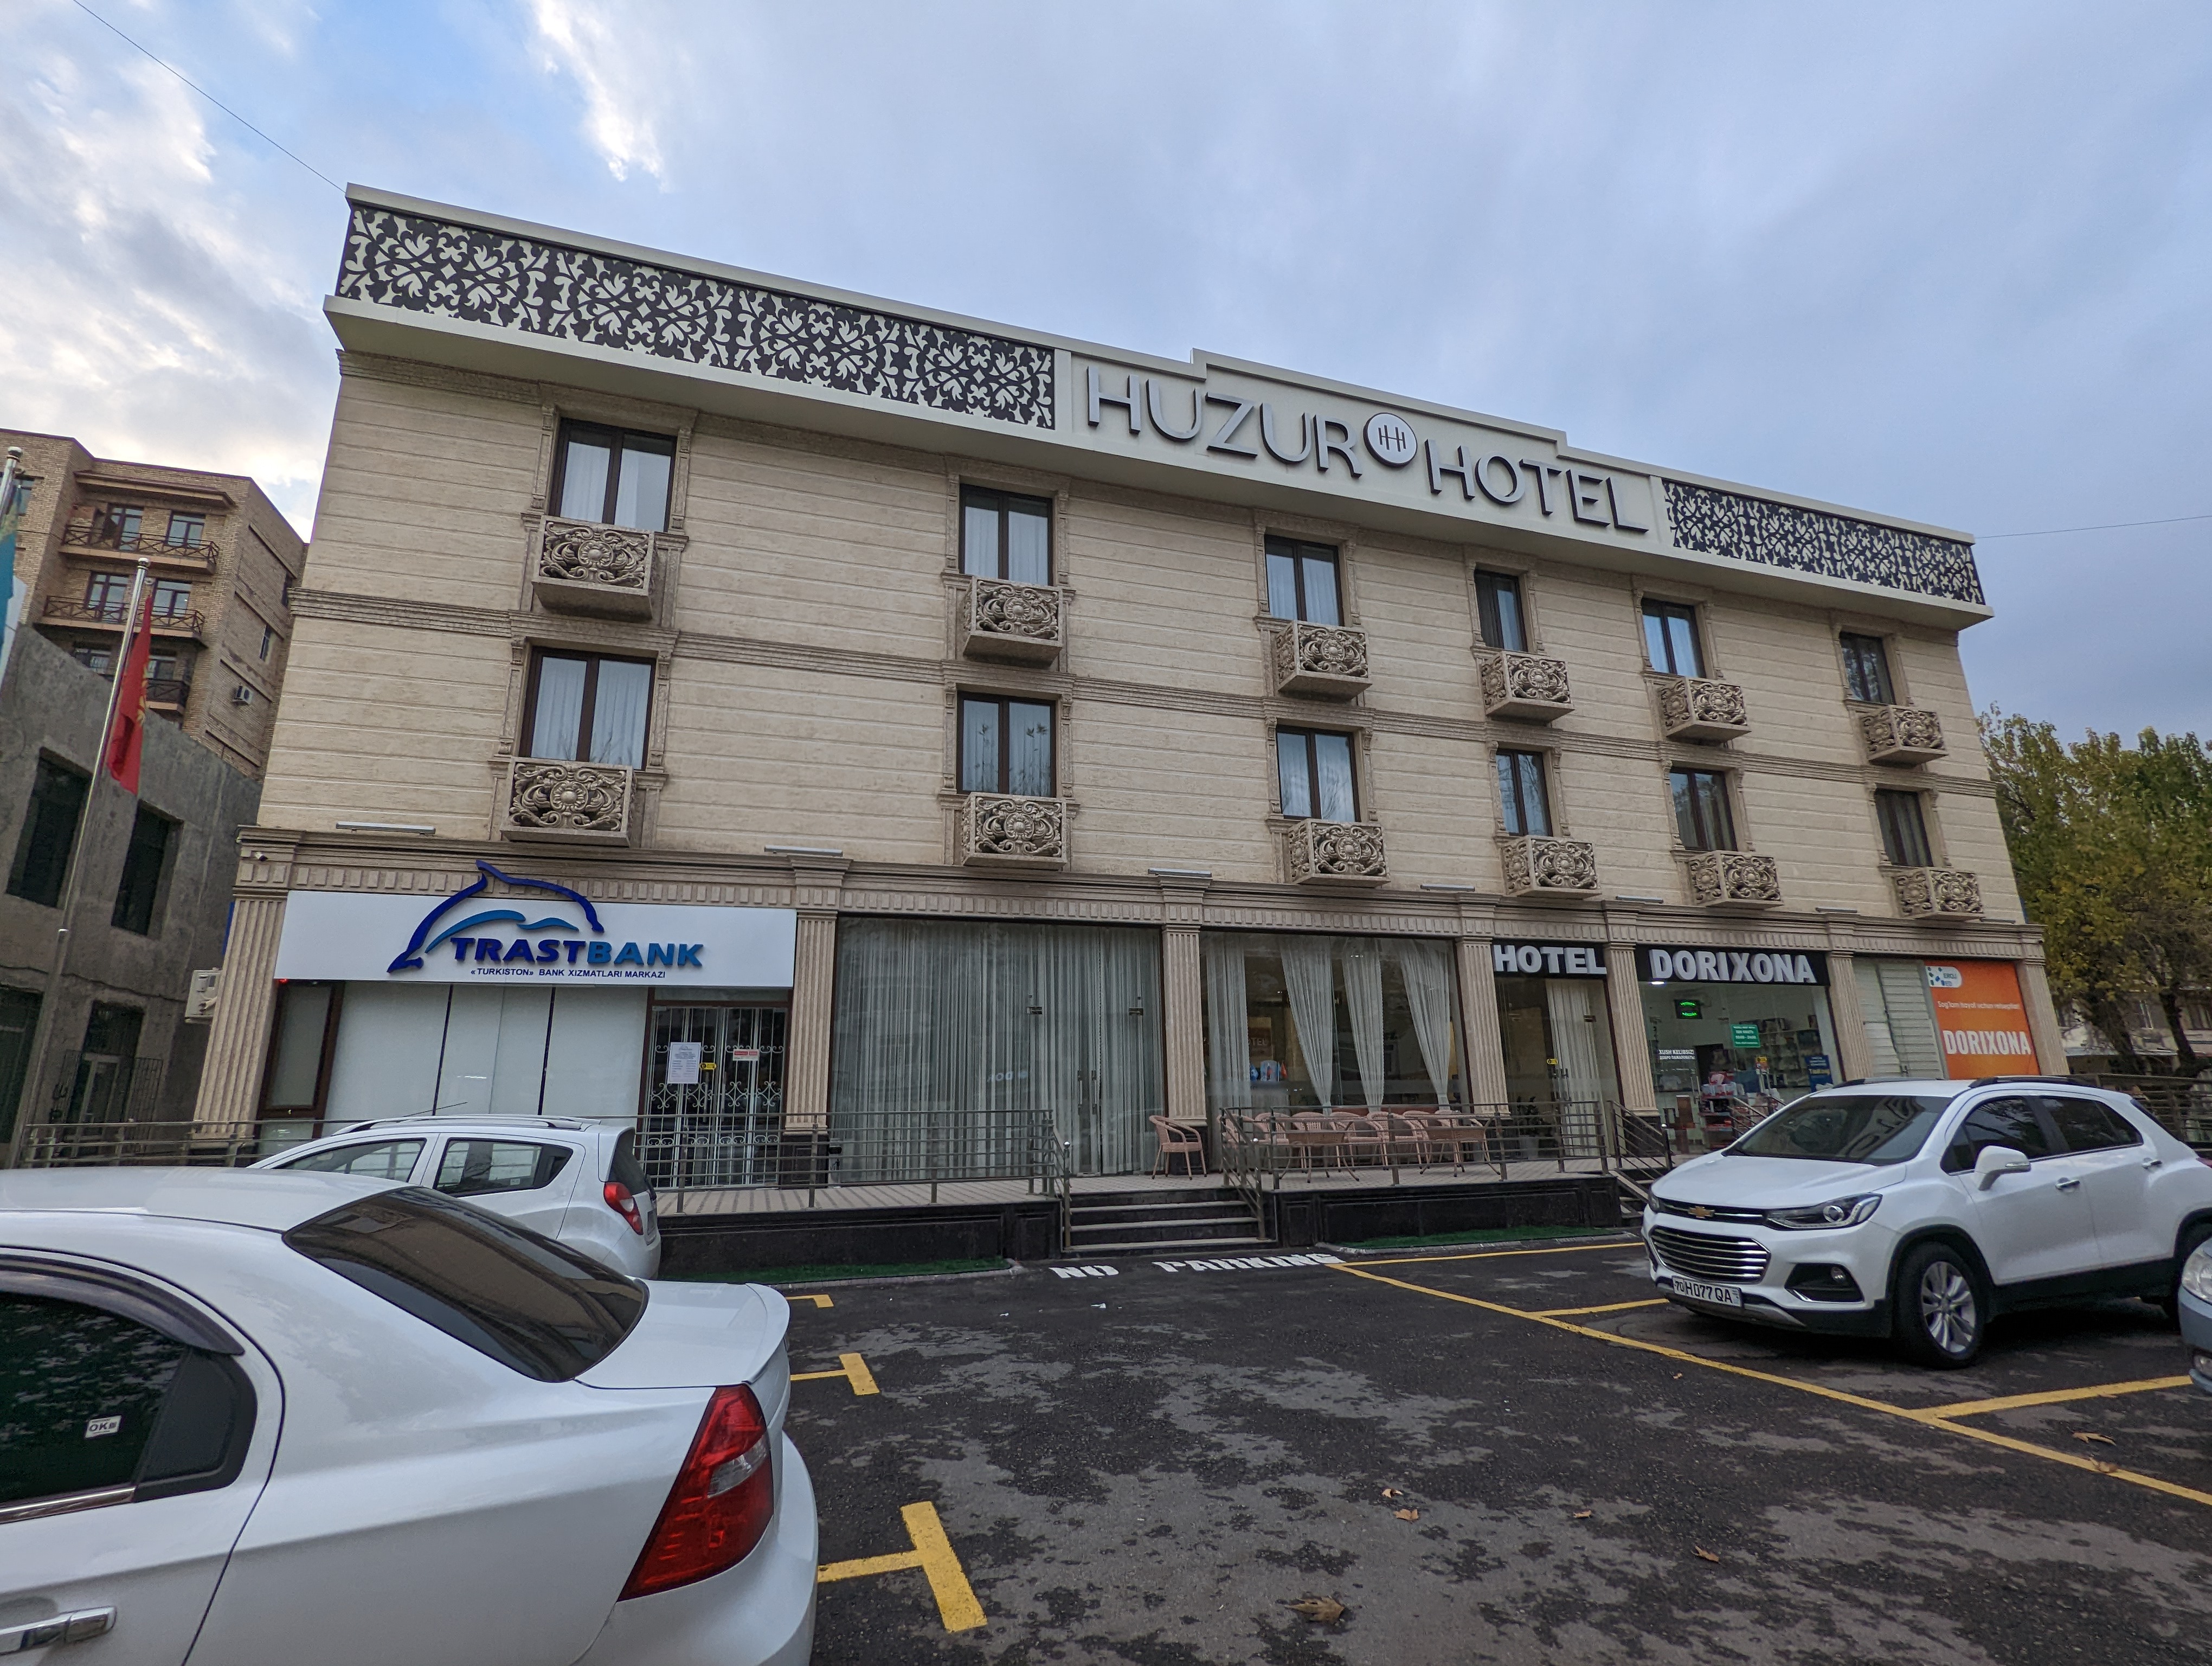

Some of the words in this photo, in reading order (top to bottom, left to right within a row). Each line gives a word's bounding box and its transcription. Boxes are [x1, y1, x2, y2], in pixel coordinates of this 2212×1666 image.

[1086, 366, 1362, 478] HUZUR
[1425, 439, 1649, 533] HOTEL
[450, 937, 703, 966] TRASTBANK
[1493, 944, 1607, 975] HOTEL
[1649, 949, 1817, 983] DORIXONA
[625, 970, 666, 978] MARKAZI
[1943, 1030, 2031, 1055] DORIXONA
[1049, 1265, 1119, 1278] NO
[1152, 1253, 1347, 1272] PARKING
